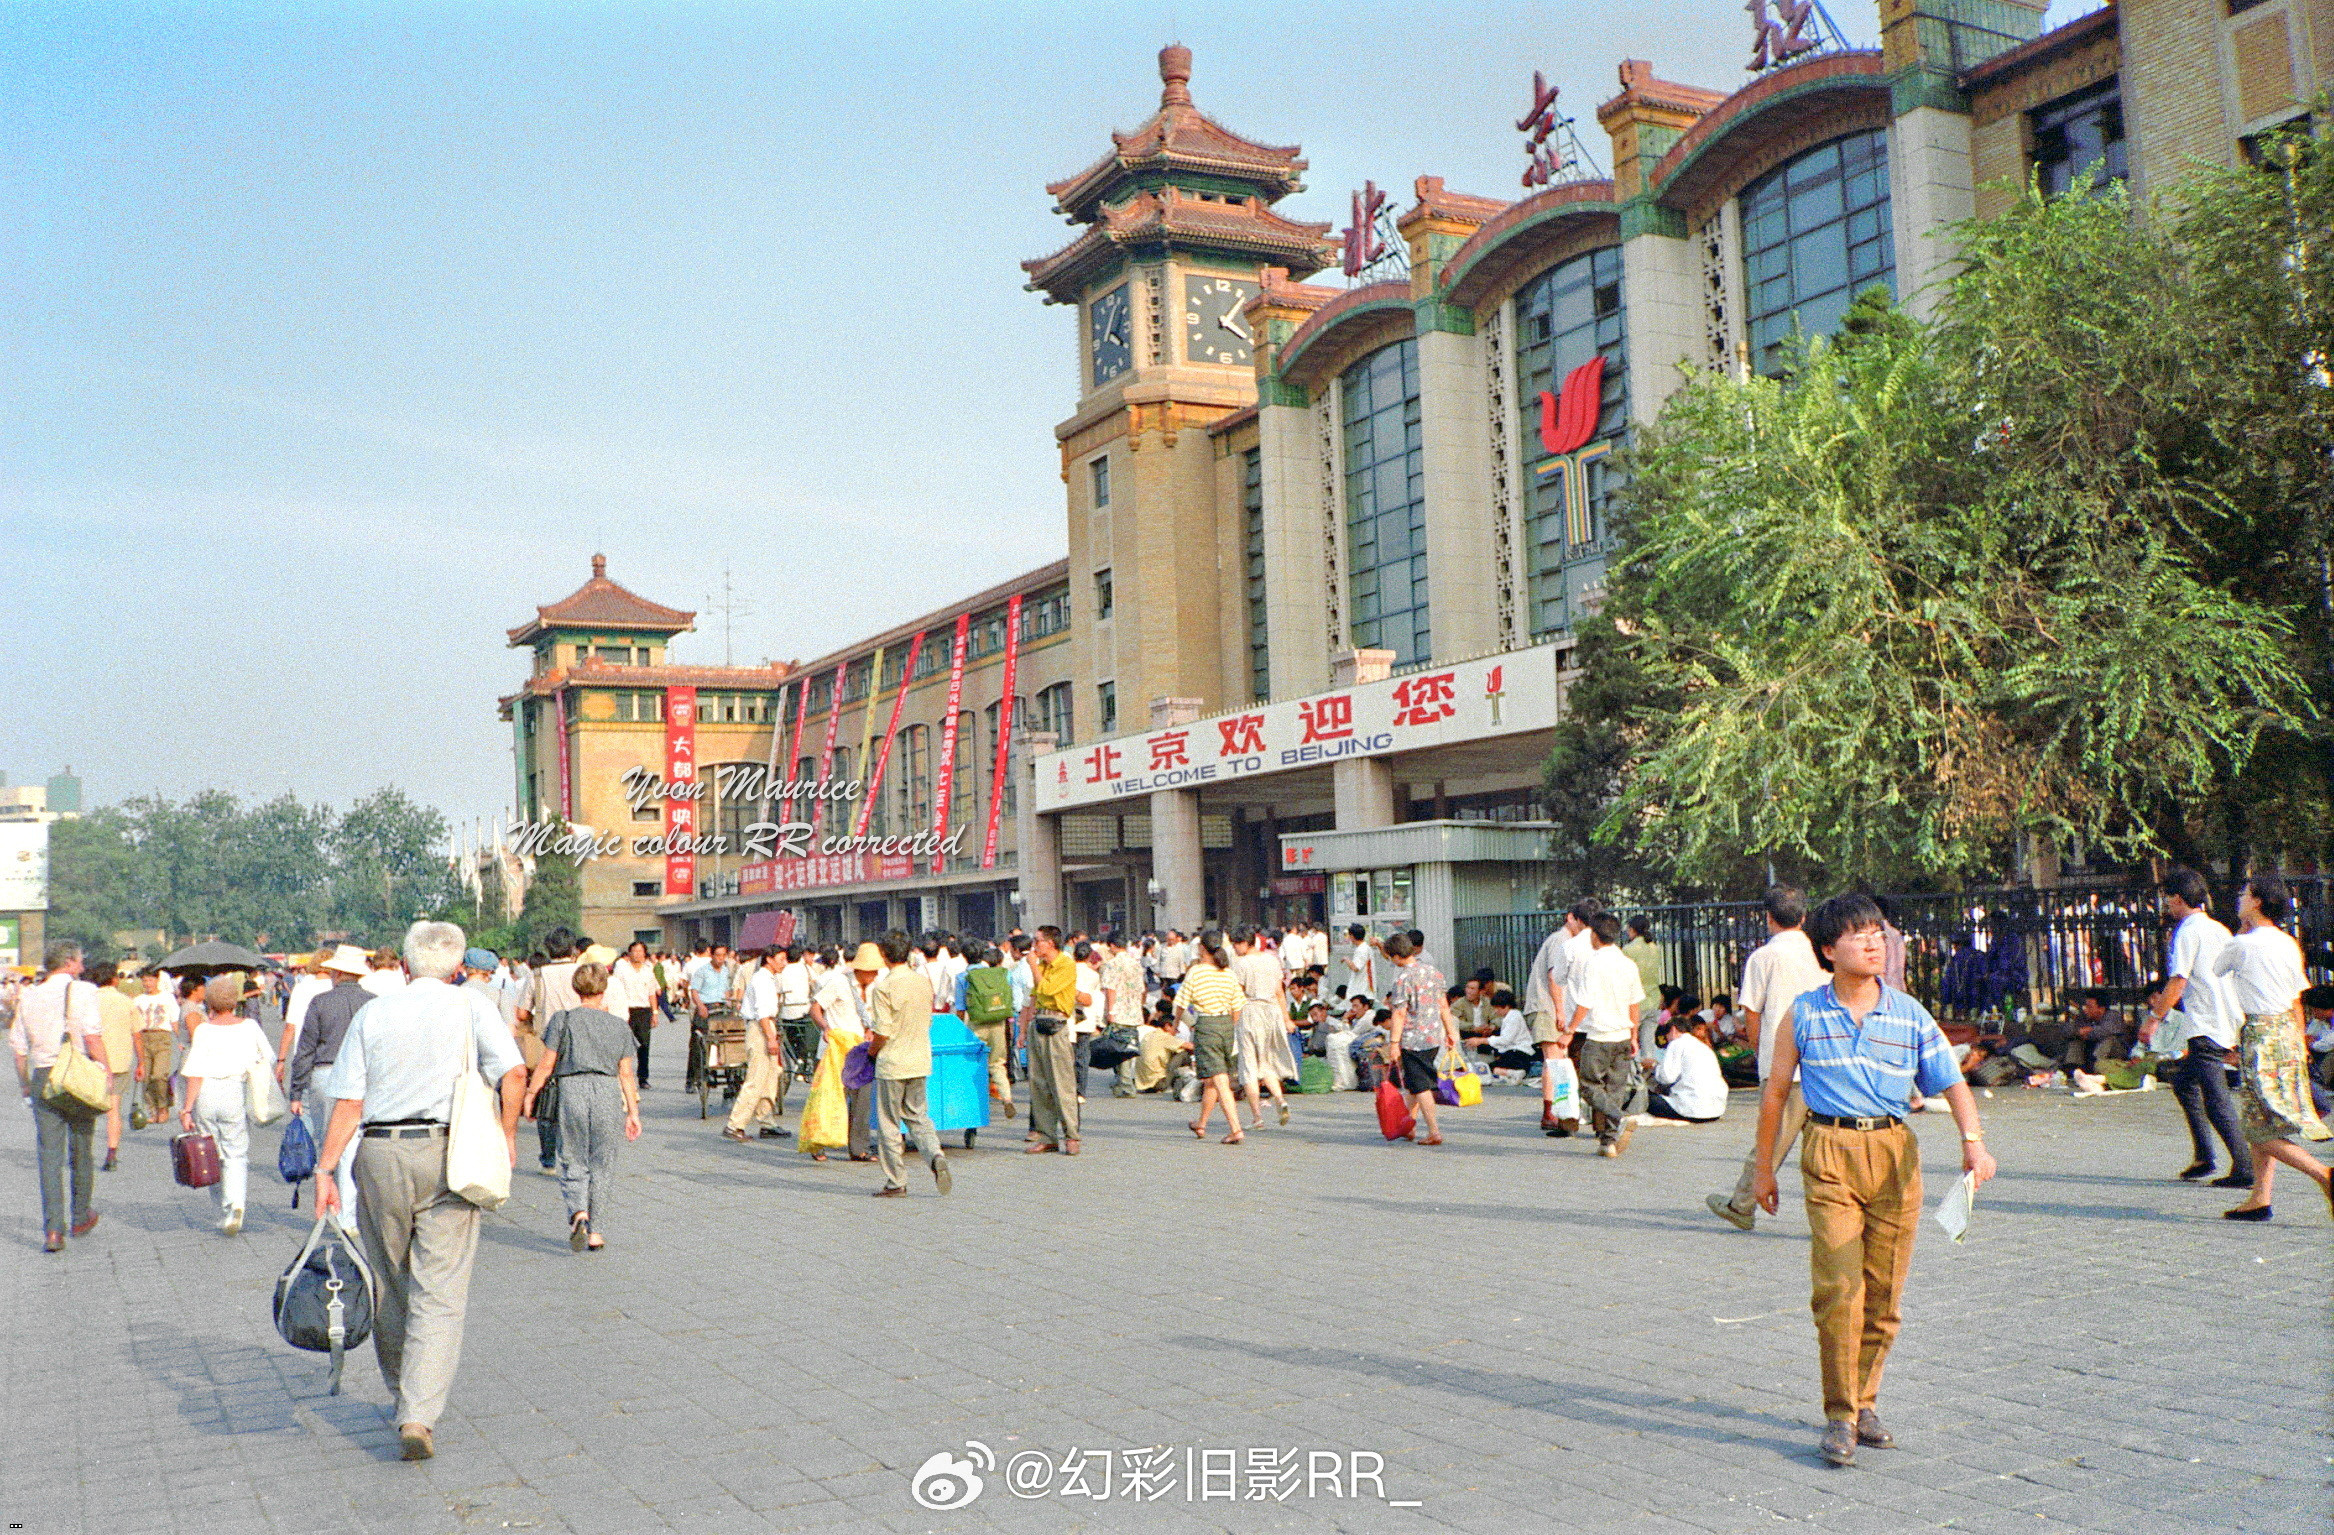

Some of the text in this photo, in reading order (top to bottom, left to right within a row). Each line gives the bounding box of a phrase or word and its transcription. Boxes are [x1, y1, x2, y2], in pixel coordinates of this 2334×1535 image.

[1216, 279, 1231, 293] 12
[1186, 312, 1200, 325] 9
[1219, 352, 1233, 364] 6
[1109, 365, 1118, 377] 6
[1085, 672, 1456, 784] 北京欢迎您
[1111, 733, 1393, 795] WELCOME TO BEIJING
